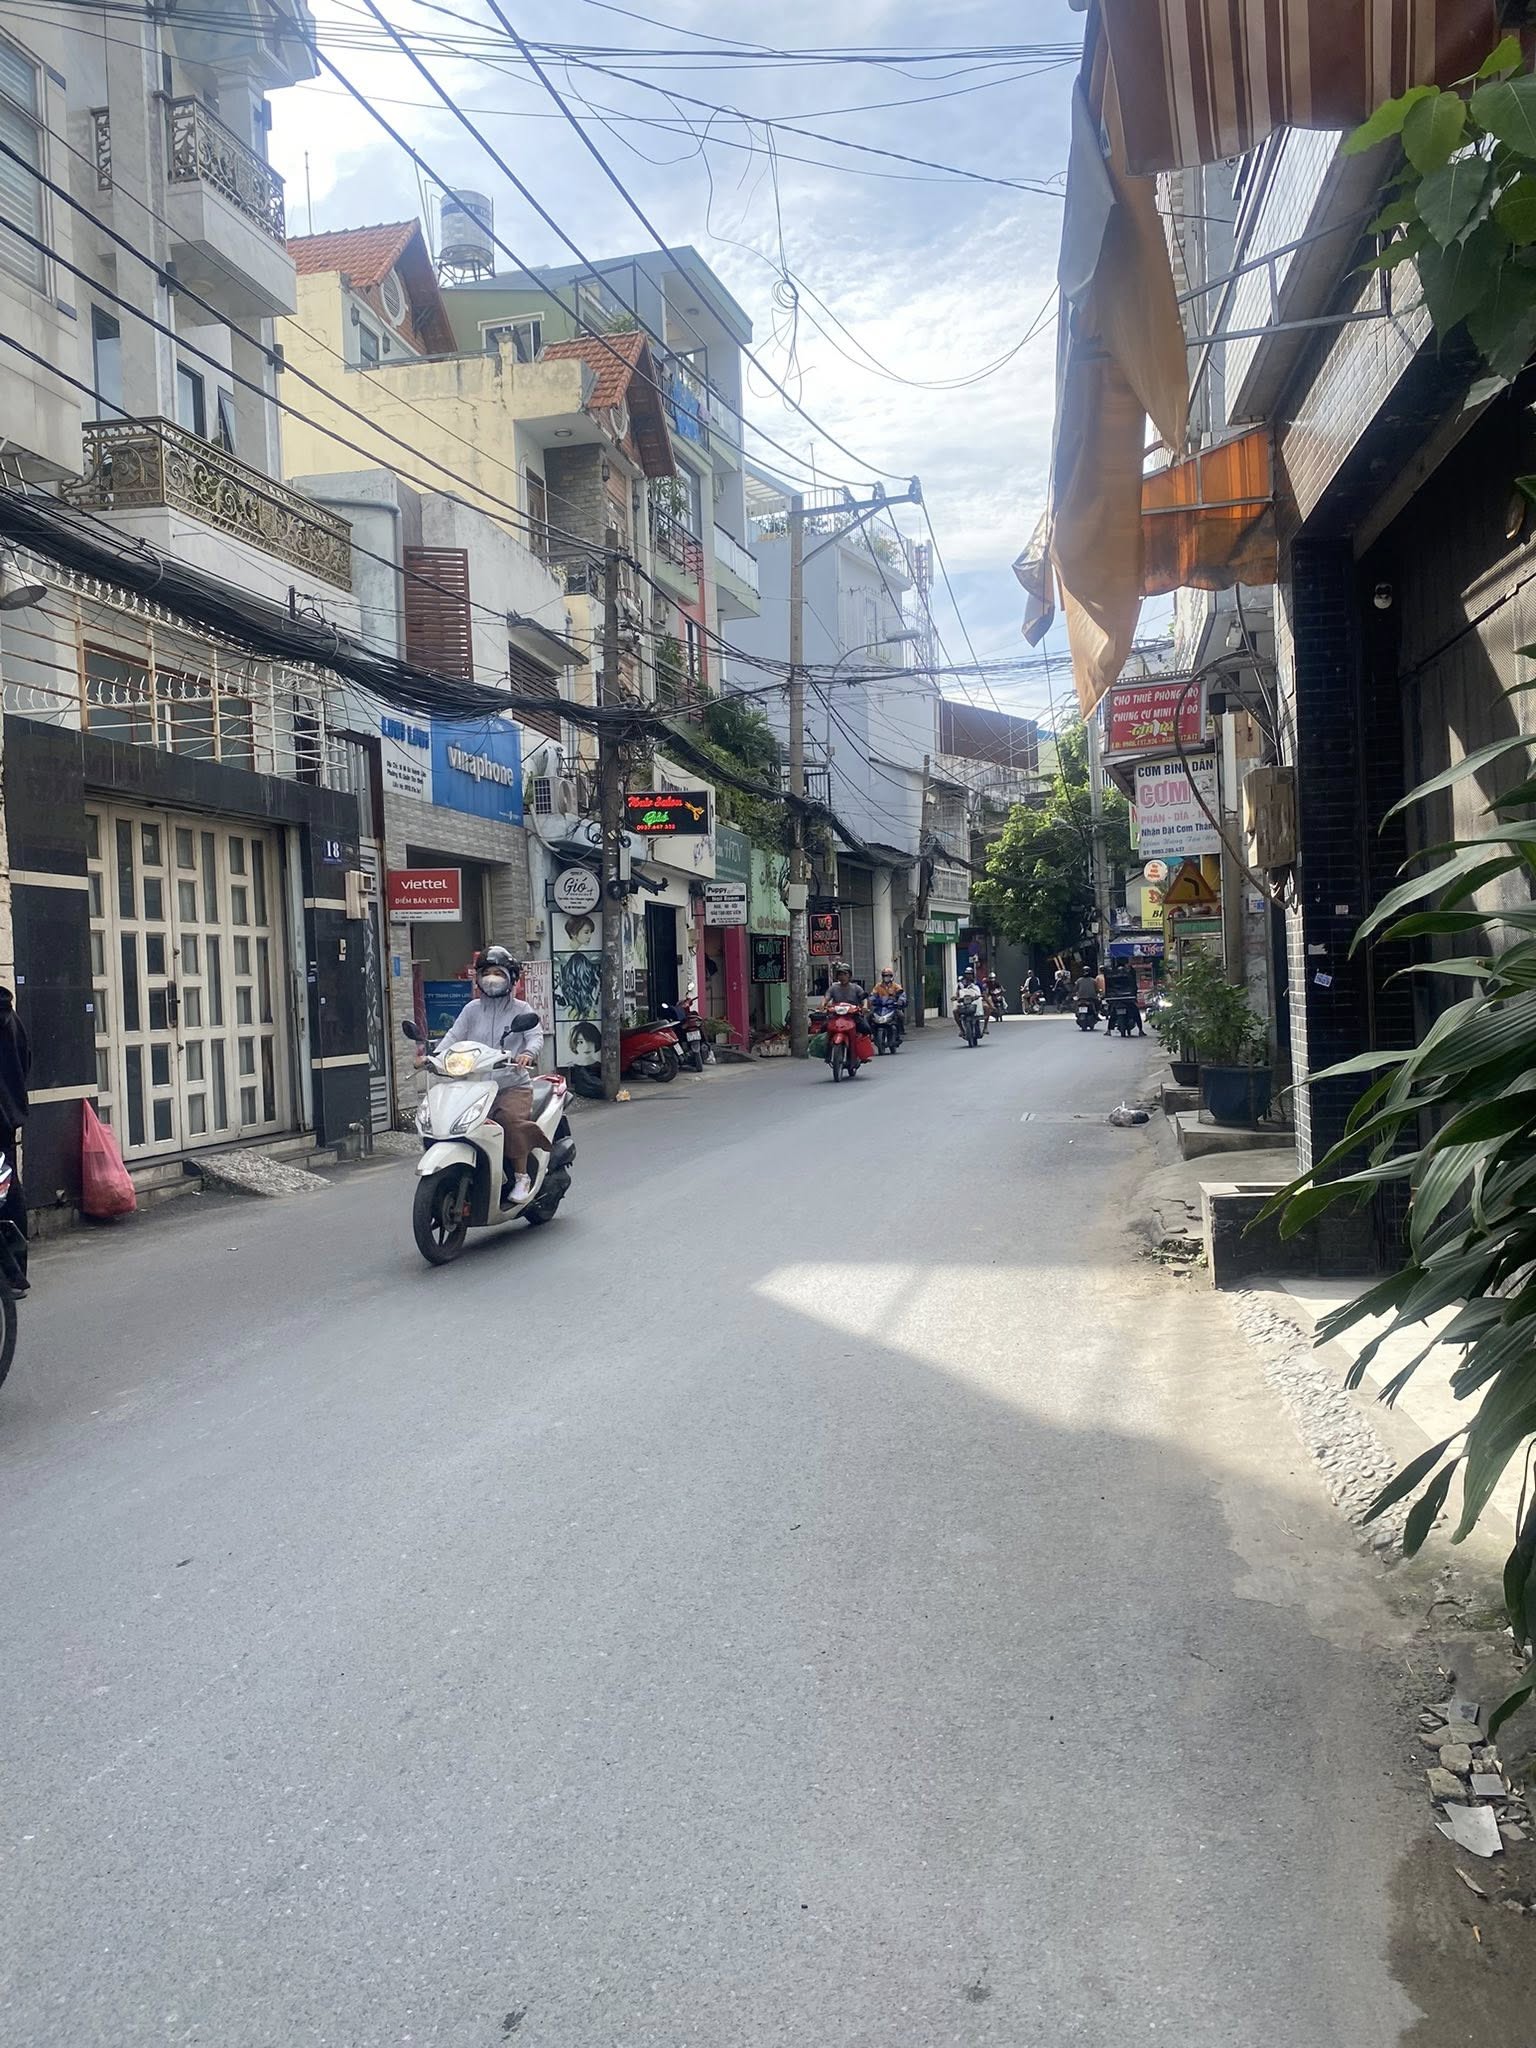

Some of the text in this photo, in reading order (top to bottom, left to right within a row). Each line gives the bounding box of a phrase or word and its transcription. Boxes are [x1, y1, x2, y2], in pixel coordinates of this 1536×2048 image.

[1113, 696, 1131, 706] CHO
[1133, 691, 1153, 704] THUÊ
[1154, 689, 1181, 701] PHÒNG
[1113, 711, 1138, 722] CHUNG
[1140, 708, 1152, 719] CƯ
[1153, 706, 1171, 718] MINI
[448, 743, 513, 787] vinaphone
[1138, 765, 1161, 778] CƠM
[1192, 758, 1214, 772] DÂN
[1140, 780, 1191, 809] CƠM
[1176, 823, 1194, 833] Cơm
[327, 840, 340, 858] 18
[401, 879, 448, 890] viettel
[564, 877, 587, 895] Gió
